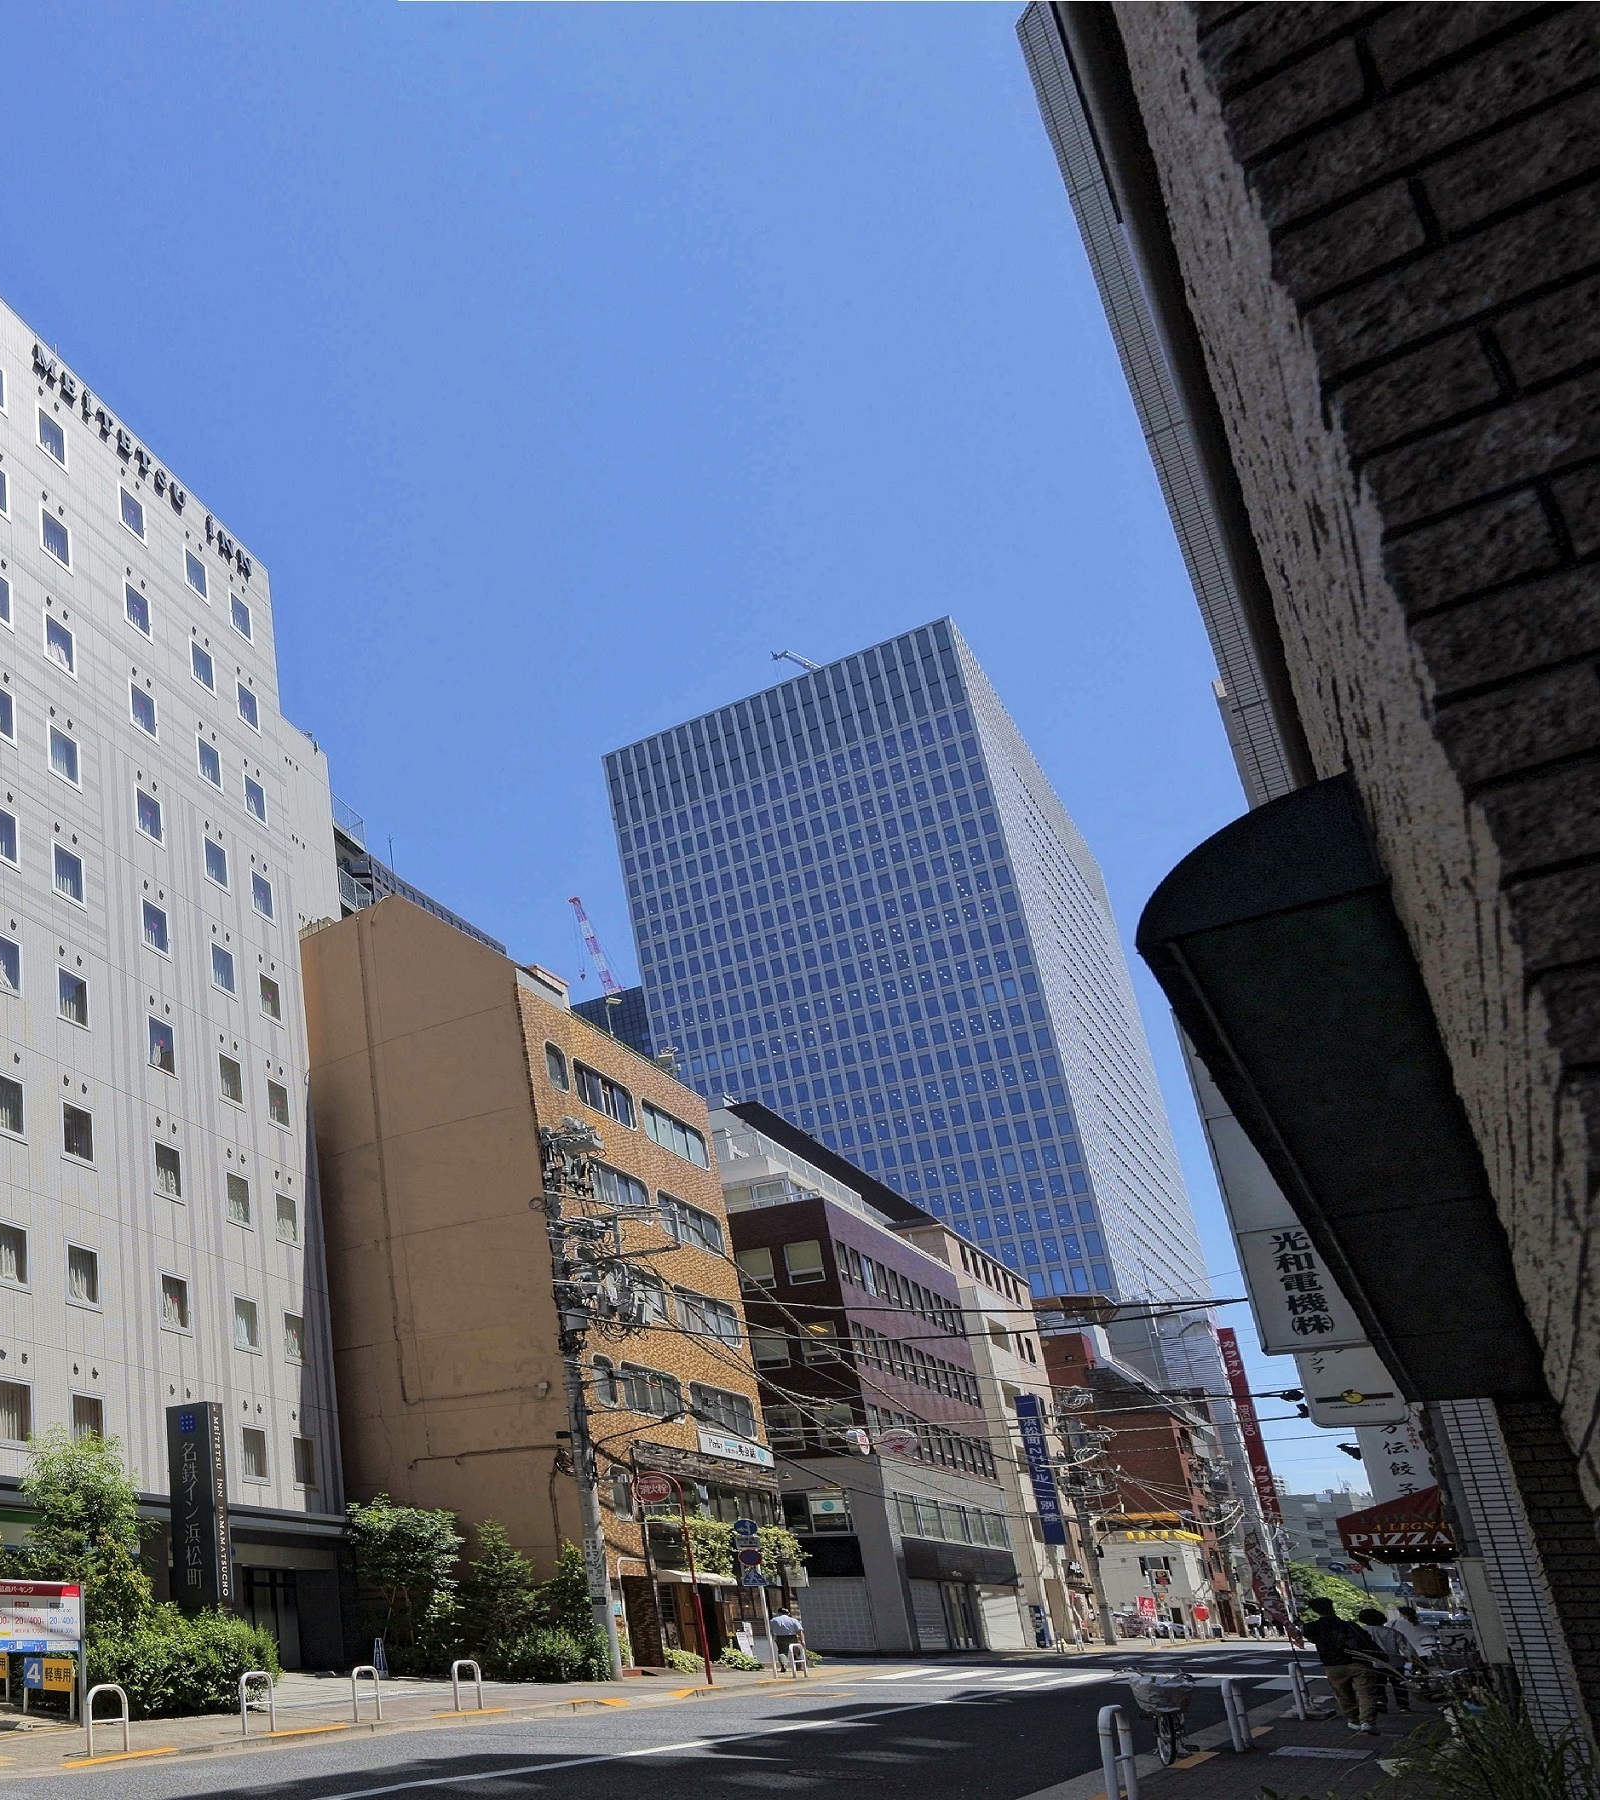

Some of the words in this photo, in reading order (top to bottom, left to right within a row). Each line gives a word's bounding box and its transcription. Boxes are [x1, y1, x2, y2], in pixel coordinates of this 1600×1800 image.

[639, 1483, 669, 1494] 消火栓
[181, 1442, 204, 1589] 名鉄イン浜松町
[1347, 1531, 1456, 1547] PIZZA
[218, 1506, 229, 1596] HAMAMATSUCHO
[26, 1663, 41, 1683] 4
[44, 1667, 71, 1683] 軽専用
